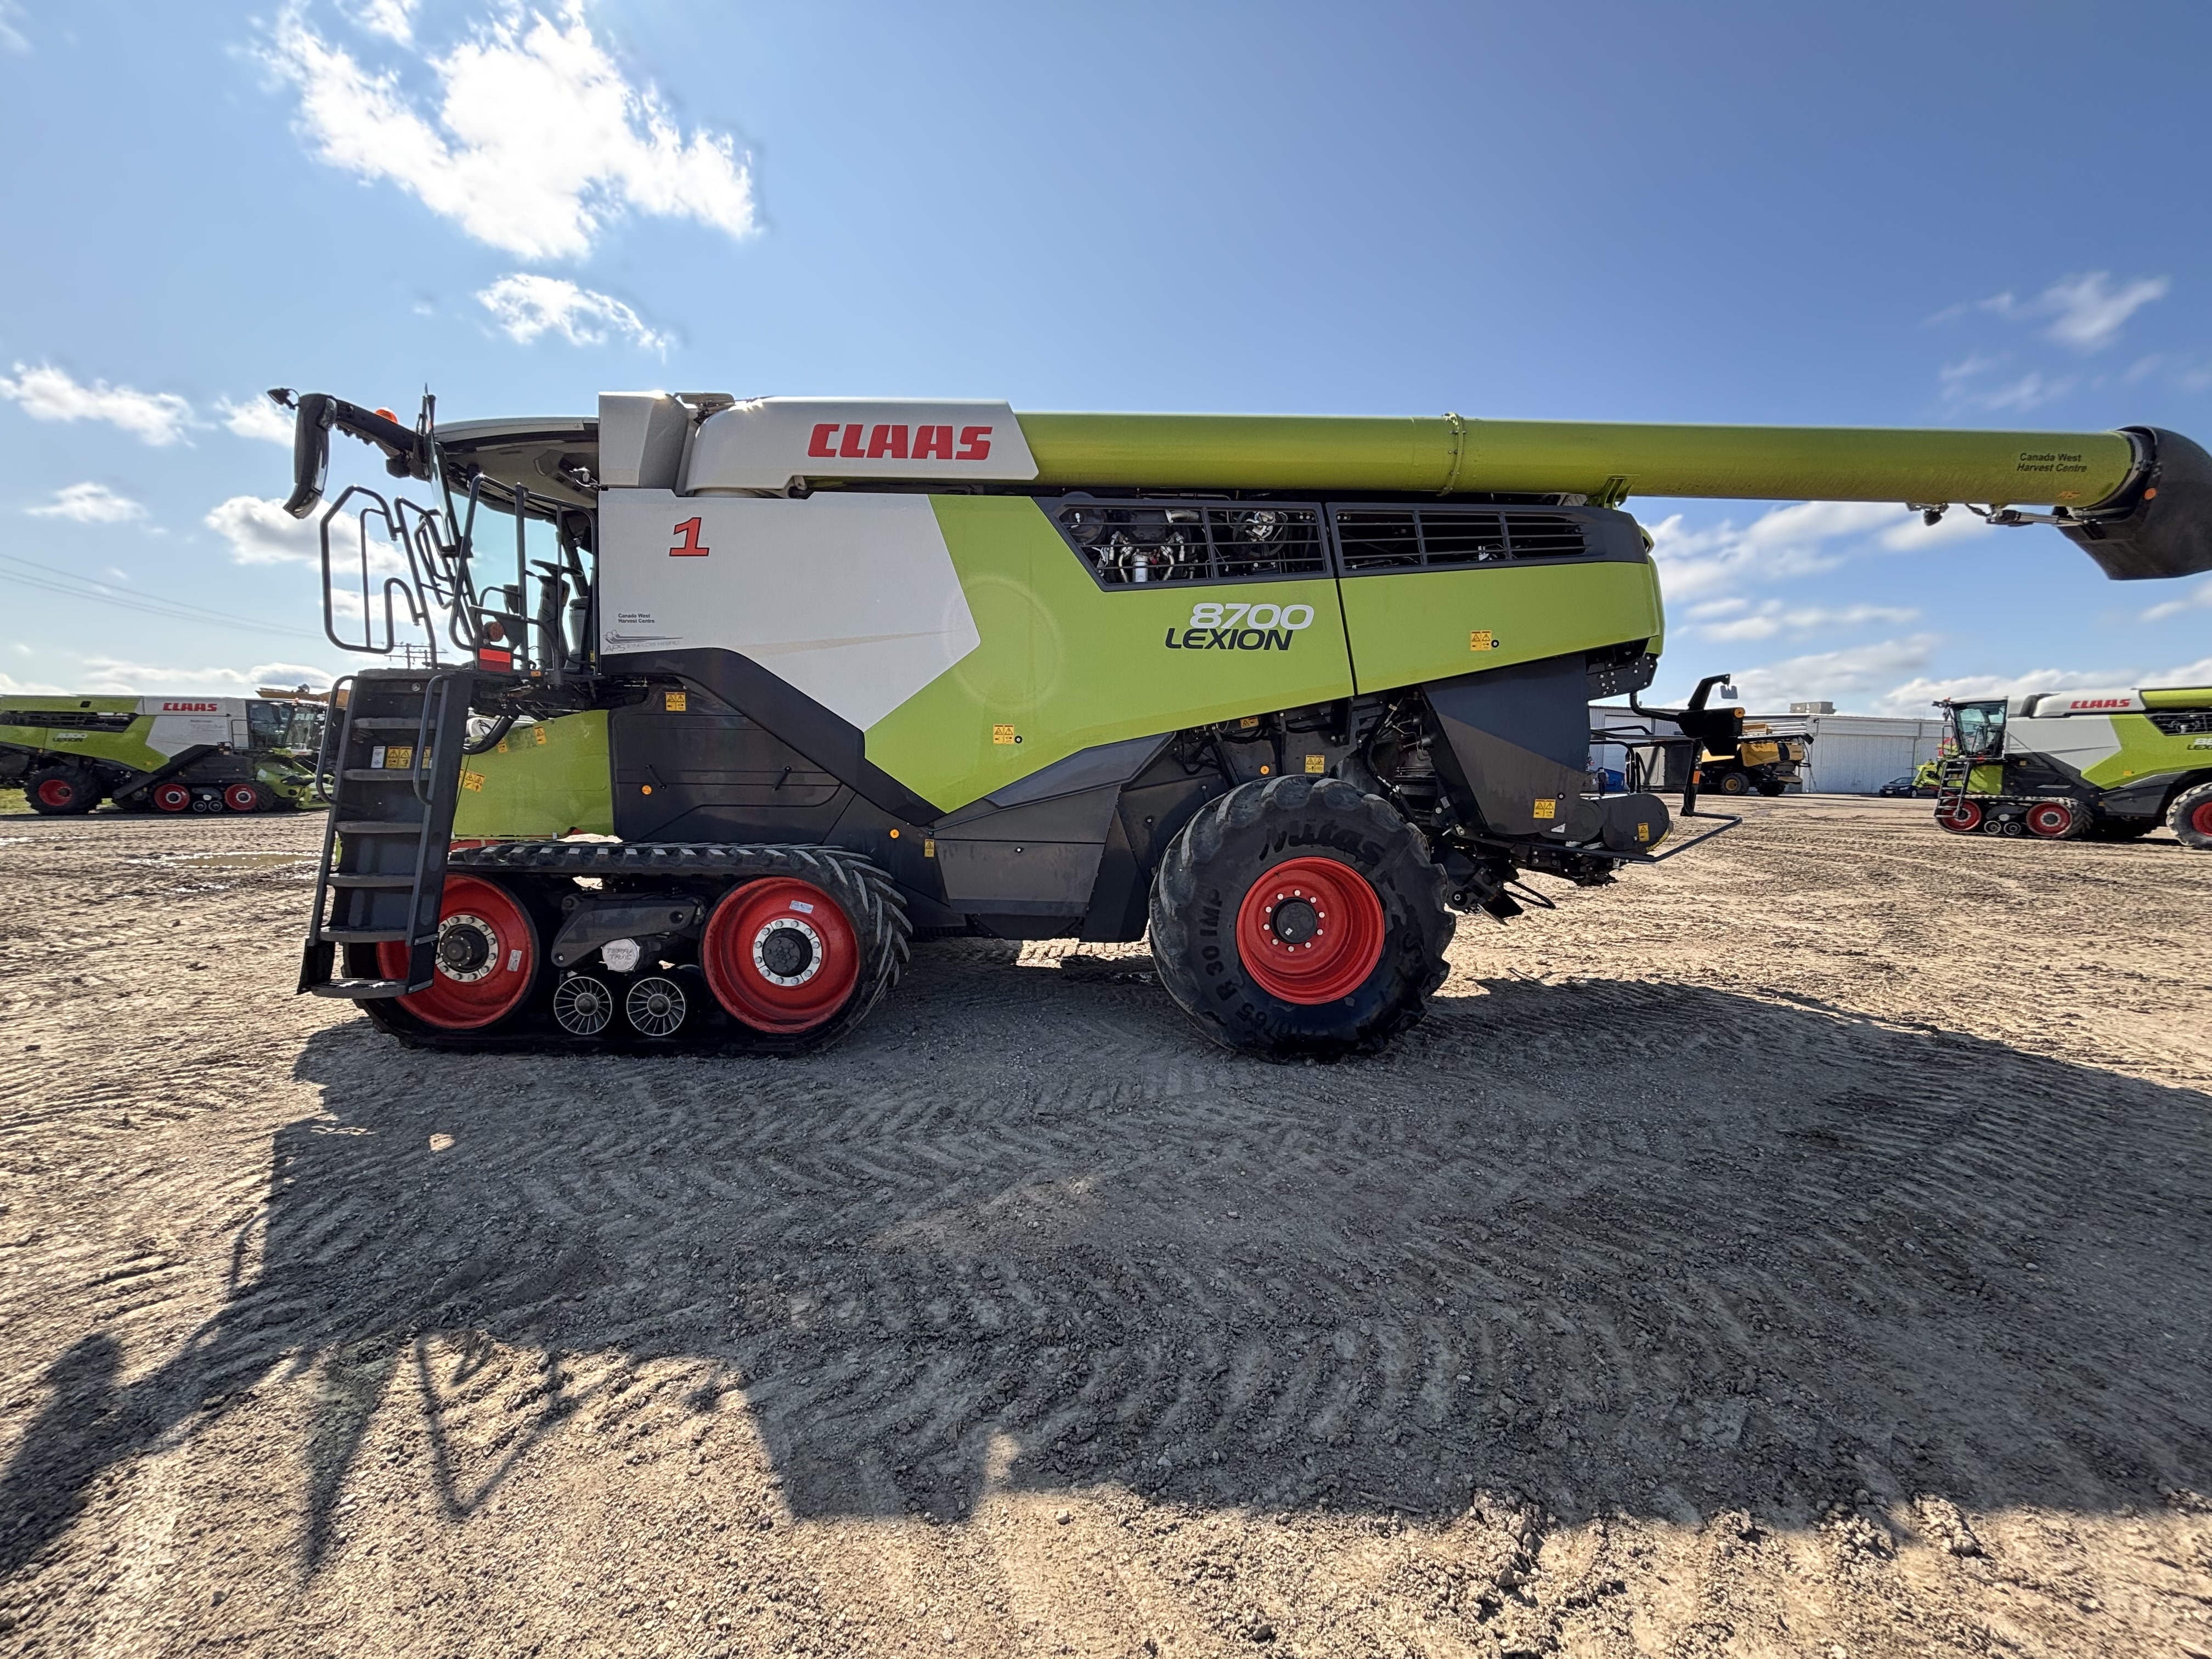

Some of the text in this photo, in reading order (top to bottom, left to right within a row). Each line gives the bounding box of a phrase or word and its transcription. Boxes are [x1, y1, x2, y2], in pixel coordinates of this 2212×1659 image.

[807, 423, 993, 460] CLAAS
[2020, 453, 2081, 461] Canada West
[2017, 463, 2087, 472] Harvest Centre
[669, 517, 710, 557] 1
[1189, 602, 1314, 630] 8700
[1165, 628, 1294, 651] LEXION
[604, 644, 625, 652] APS
[162, 702, 218, 712] CLAAS
[2070, 698, 2132, 709] CLAAS
